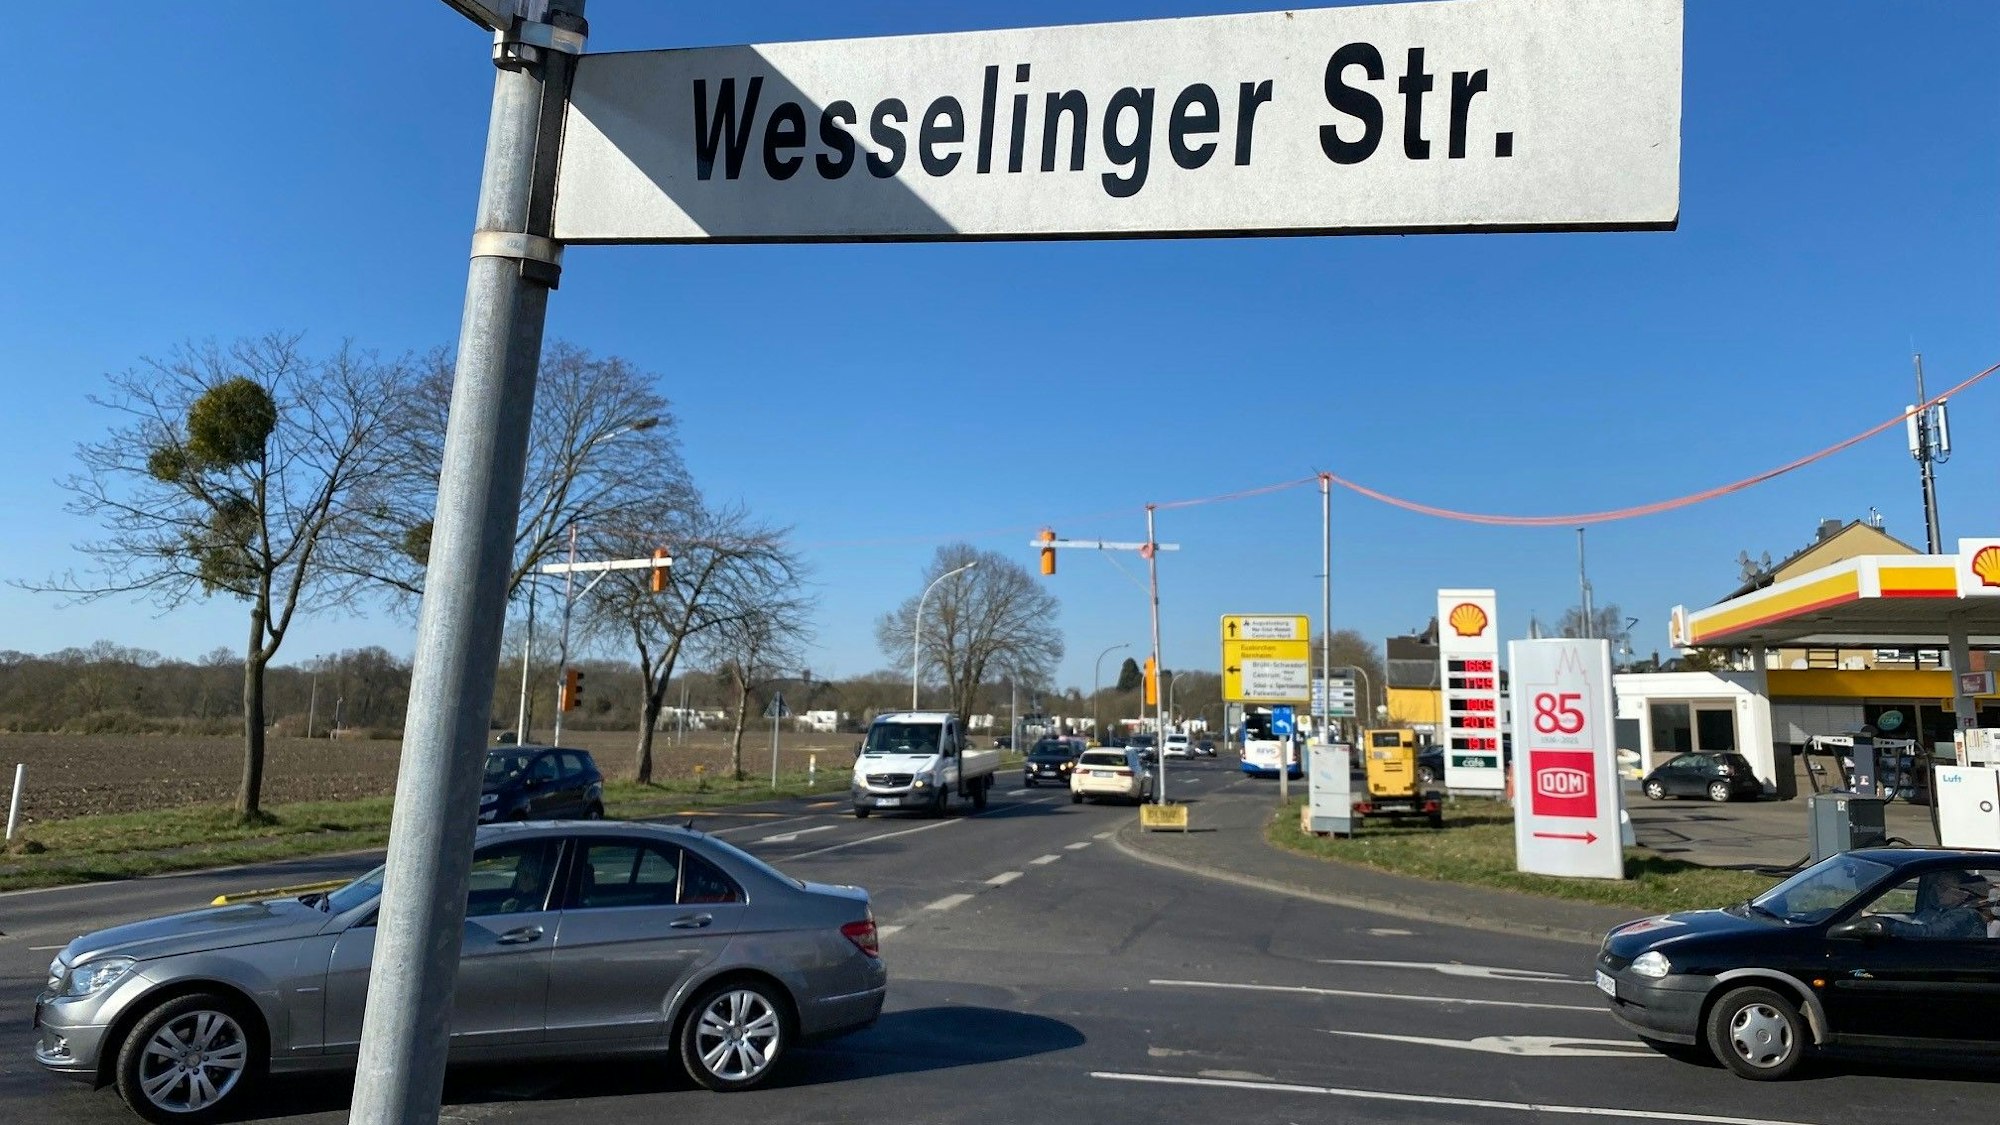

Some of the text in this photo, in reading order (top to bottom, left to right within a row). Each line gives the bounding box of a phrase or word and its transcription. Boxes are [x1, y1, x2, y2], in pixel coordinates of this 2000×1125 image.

[693, 43, 1513, 198] Wesselinger Str.
[1535, 693, 1584, 733] 85
[1542, 773, 1583, 793] DOM
[1943, 774, 1962, 783] Luft
